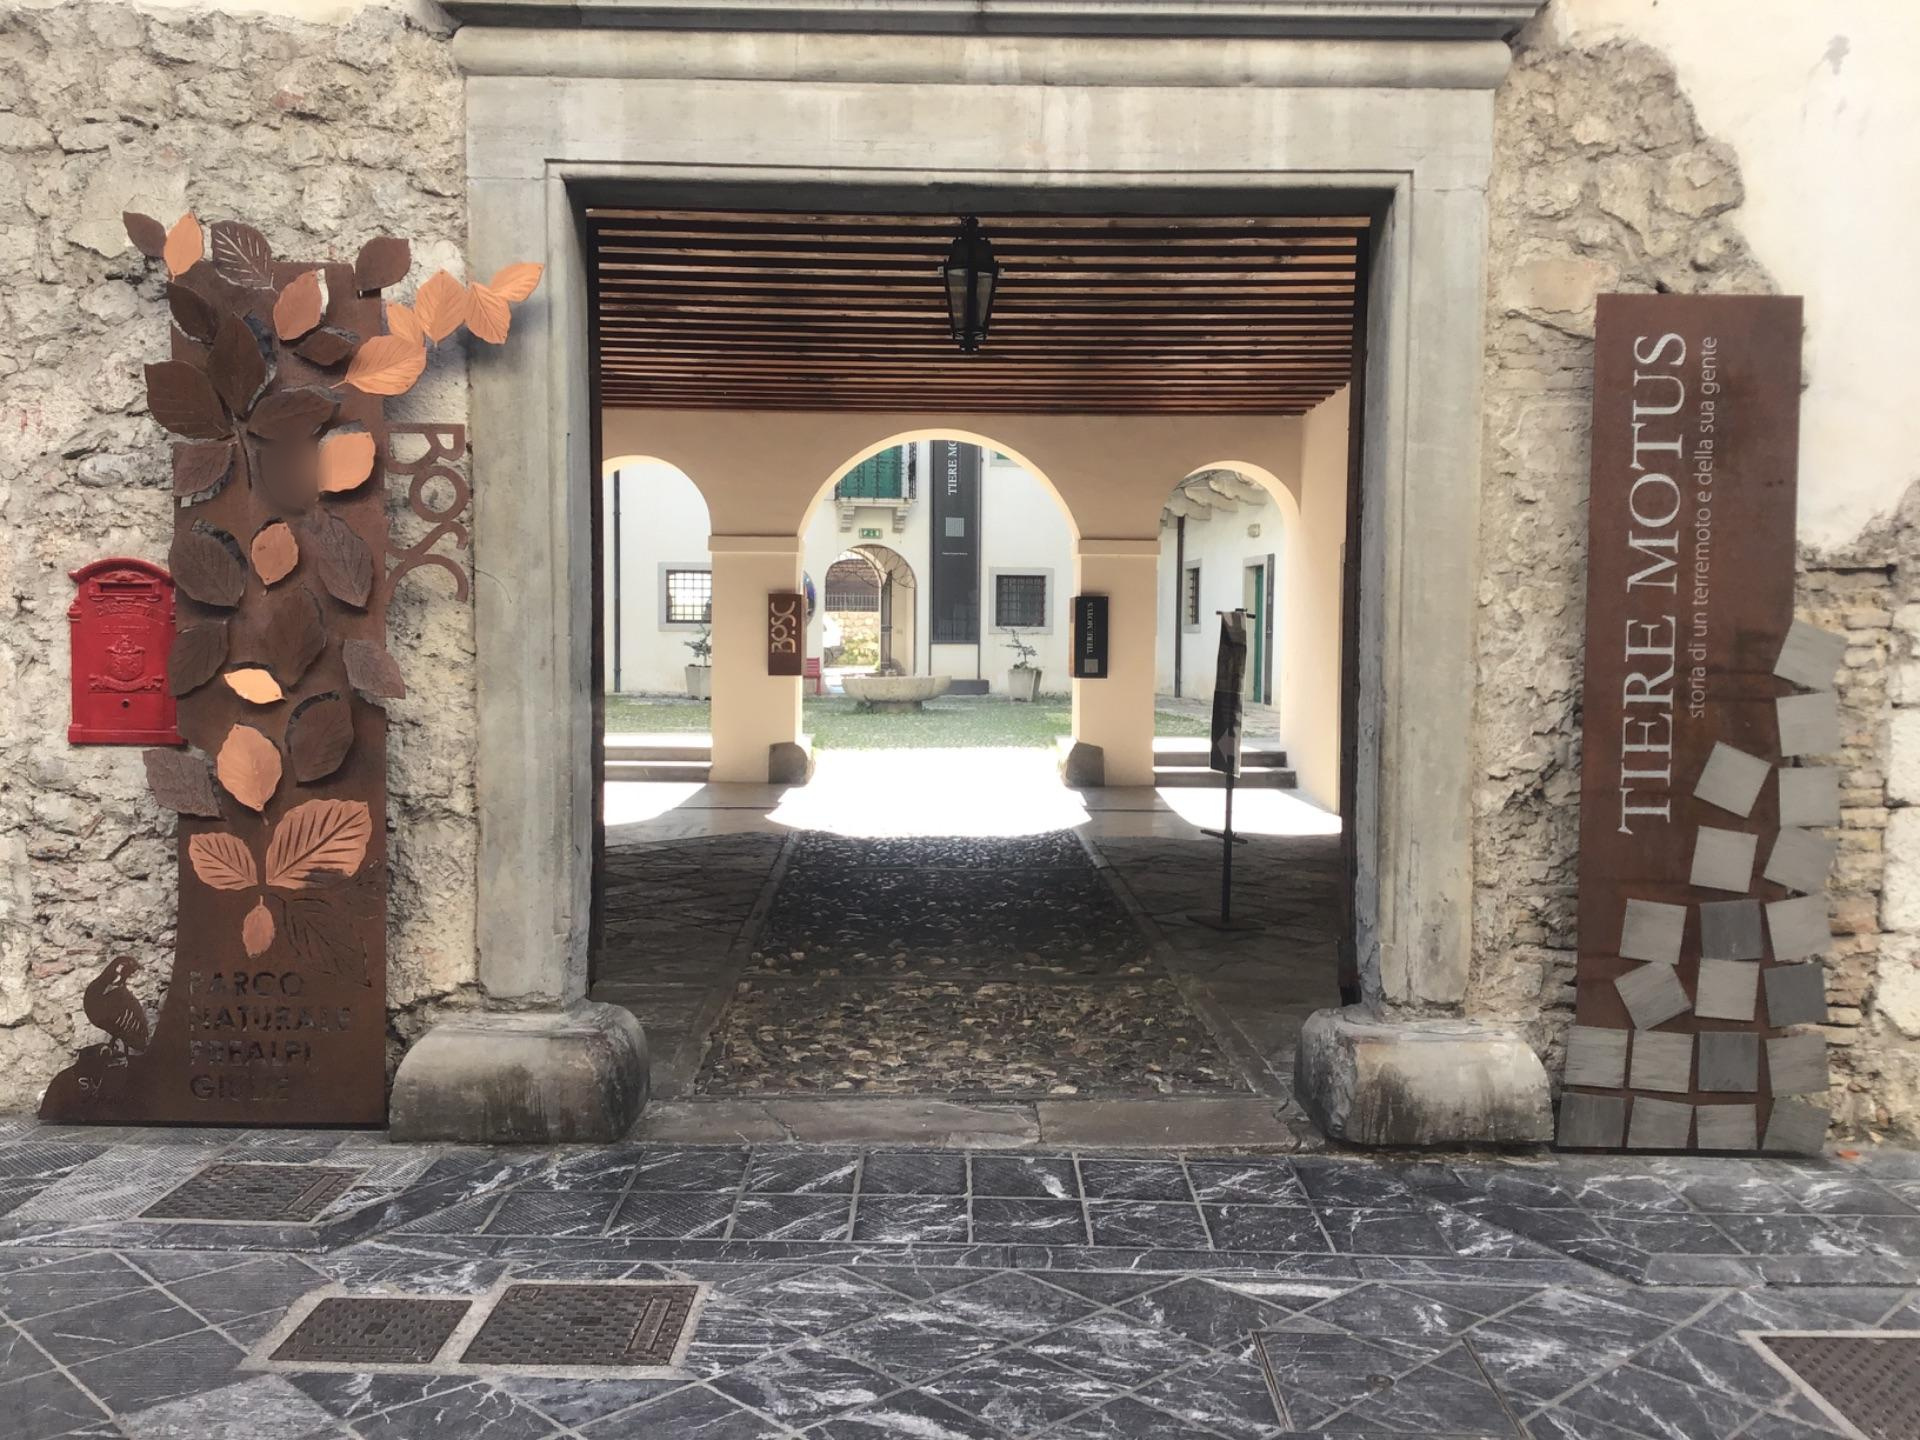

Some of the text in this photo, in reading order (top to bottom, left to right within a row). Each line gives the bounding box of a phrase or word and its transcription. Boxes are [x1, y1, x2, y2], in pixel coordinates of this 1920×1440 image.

[947, 459, 958, 496] TIERE
[1687, 336, 1720, 719] storia di un terremoto e della sua gente
[1617, 331, 1687, 835] TIERE MOTUS
[188, 970, 306, 998] PARCO
[188, 1004, 353, 1033] NATURALE
